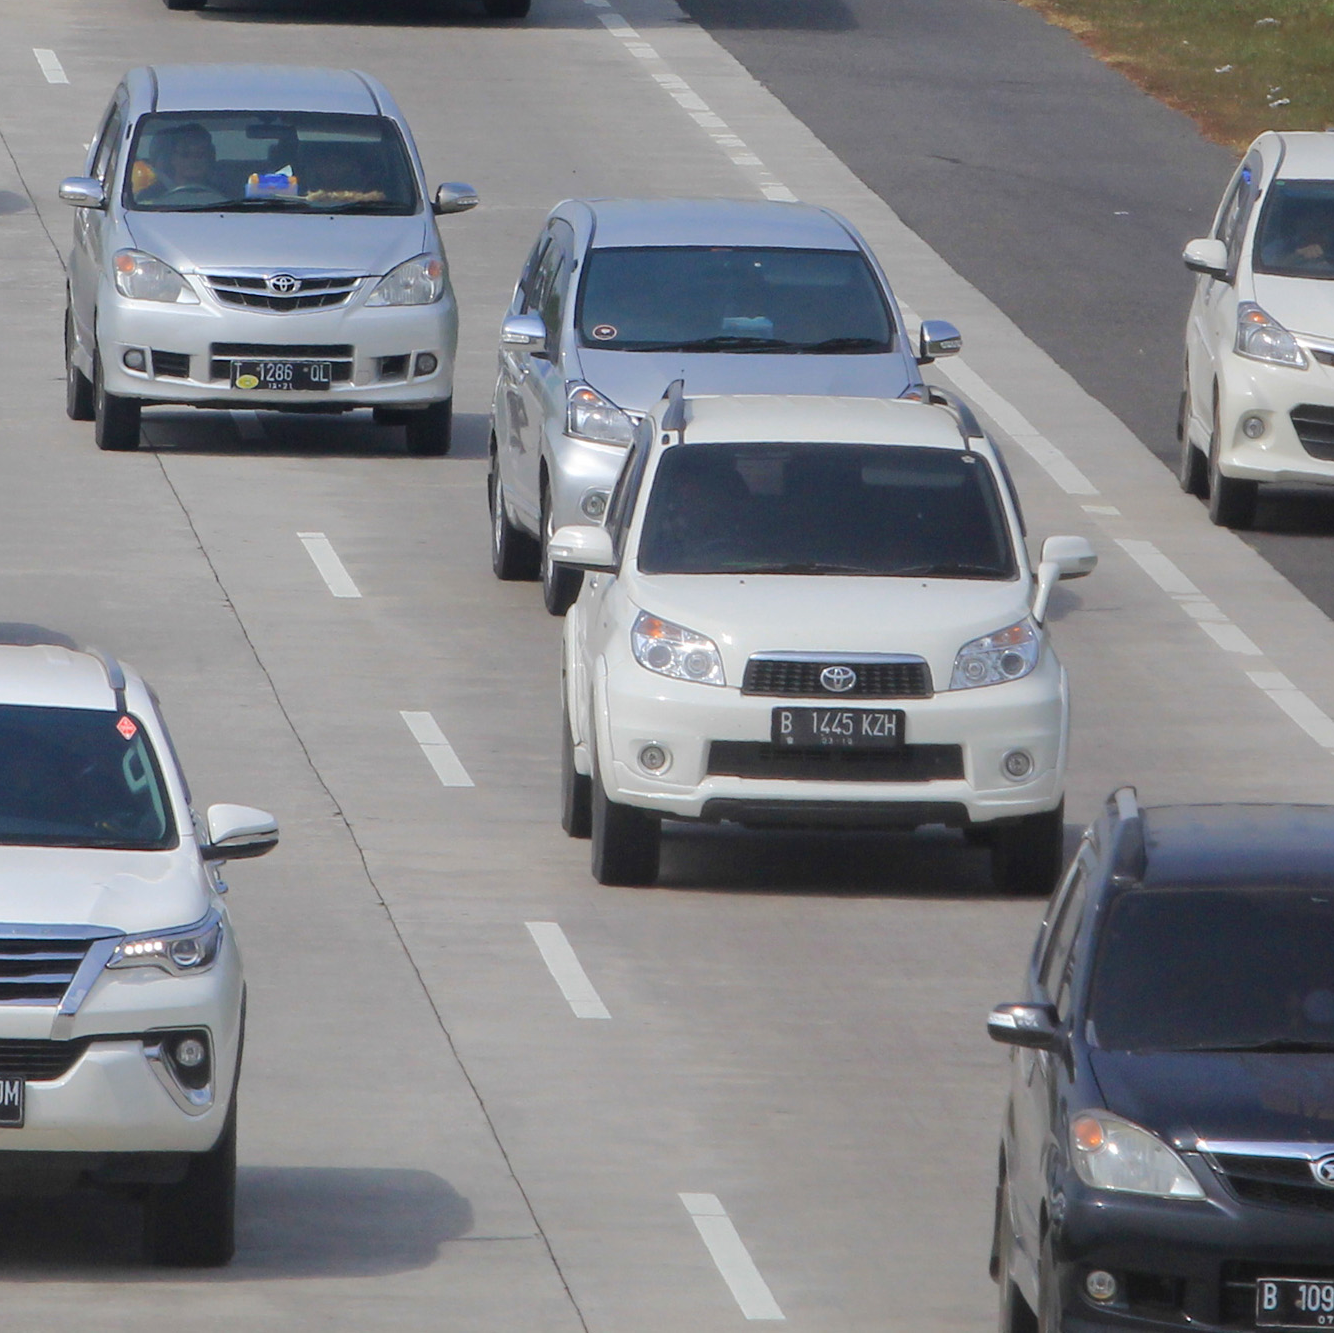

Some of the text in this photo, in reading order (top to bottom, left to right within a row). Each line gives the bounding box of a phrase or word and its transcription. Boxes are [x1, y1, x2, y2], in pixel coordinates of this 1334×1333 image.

[259, 363, 293, 381] 1286
[310, 365, 329, 382] QL
[780, 711, 897, 737] B 1445 KZH
[1263, 1282, 1278, 1310] B
